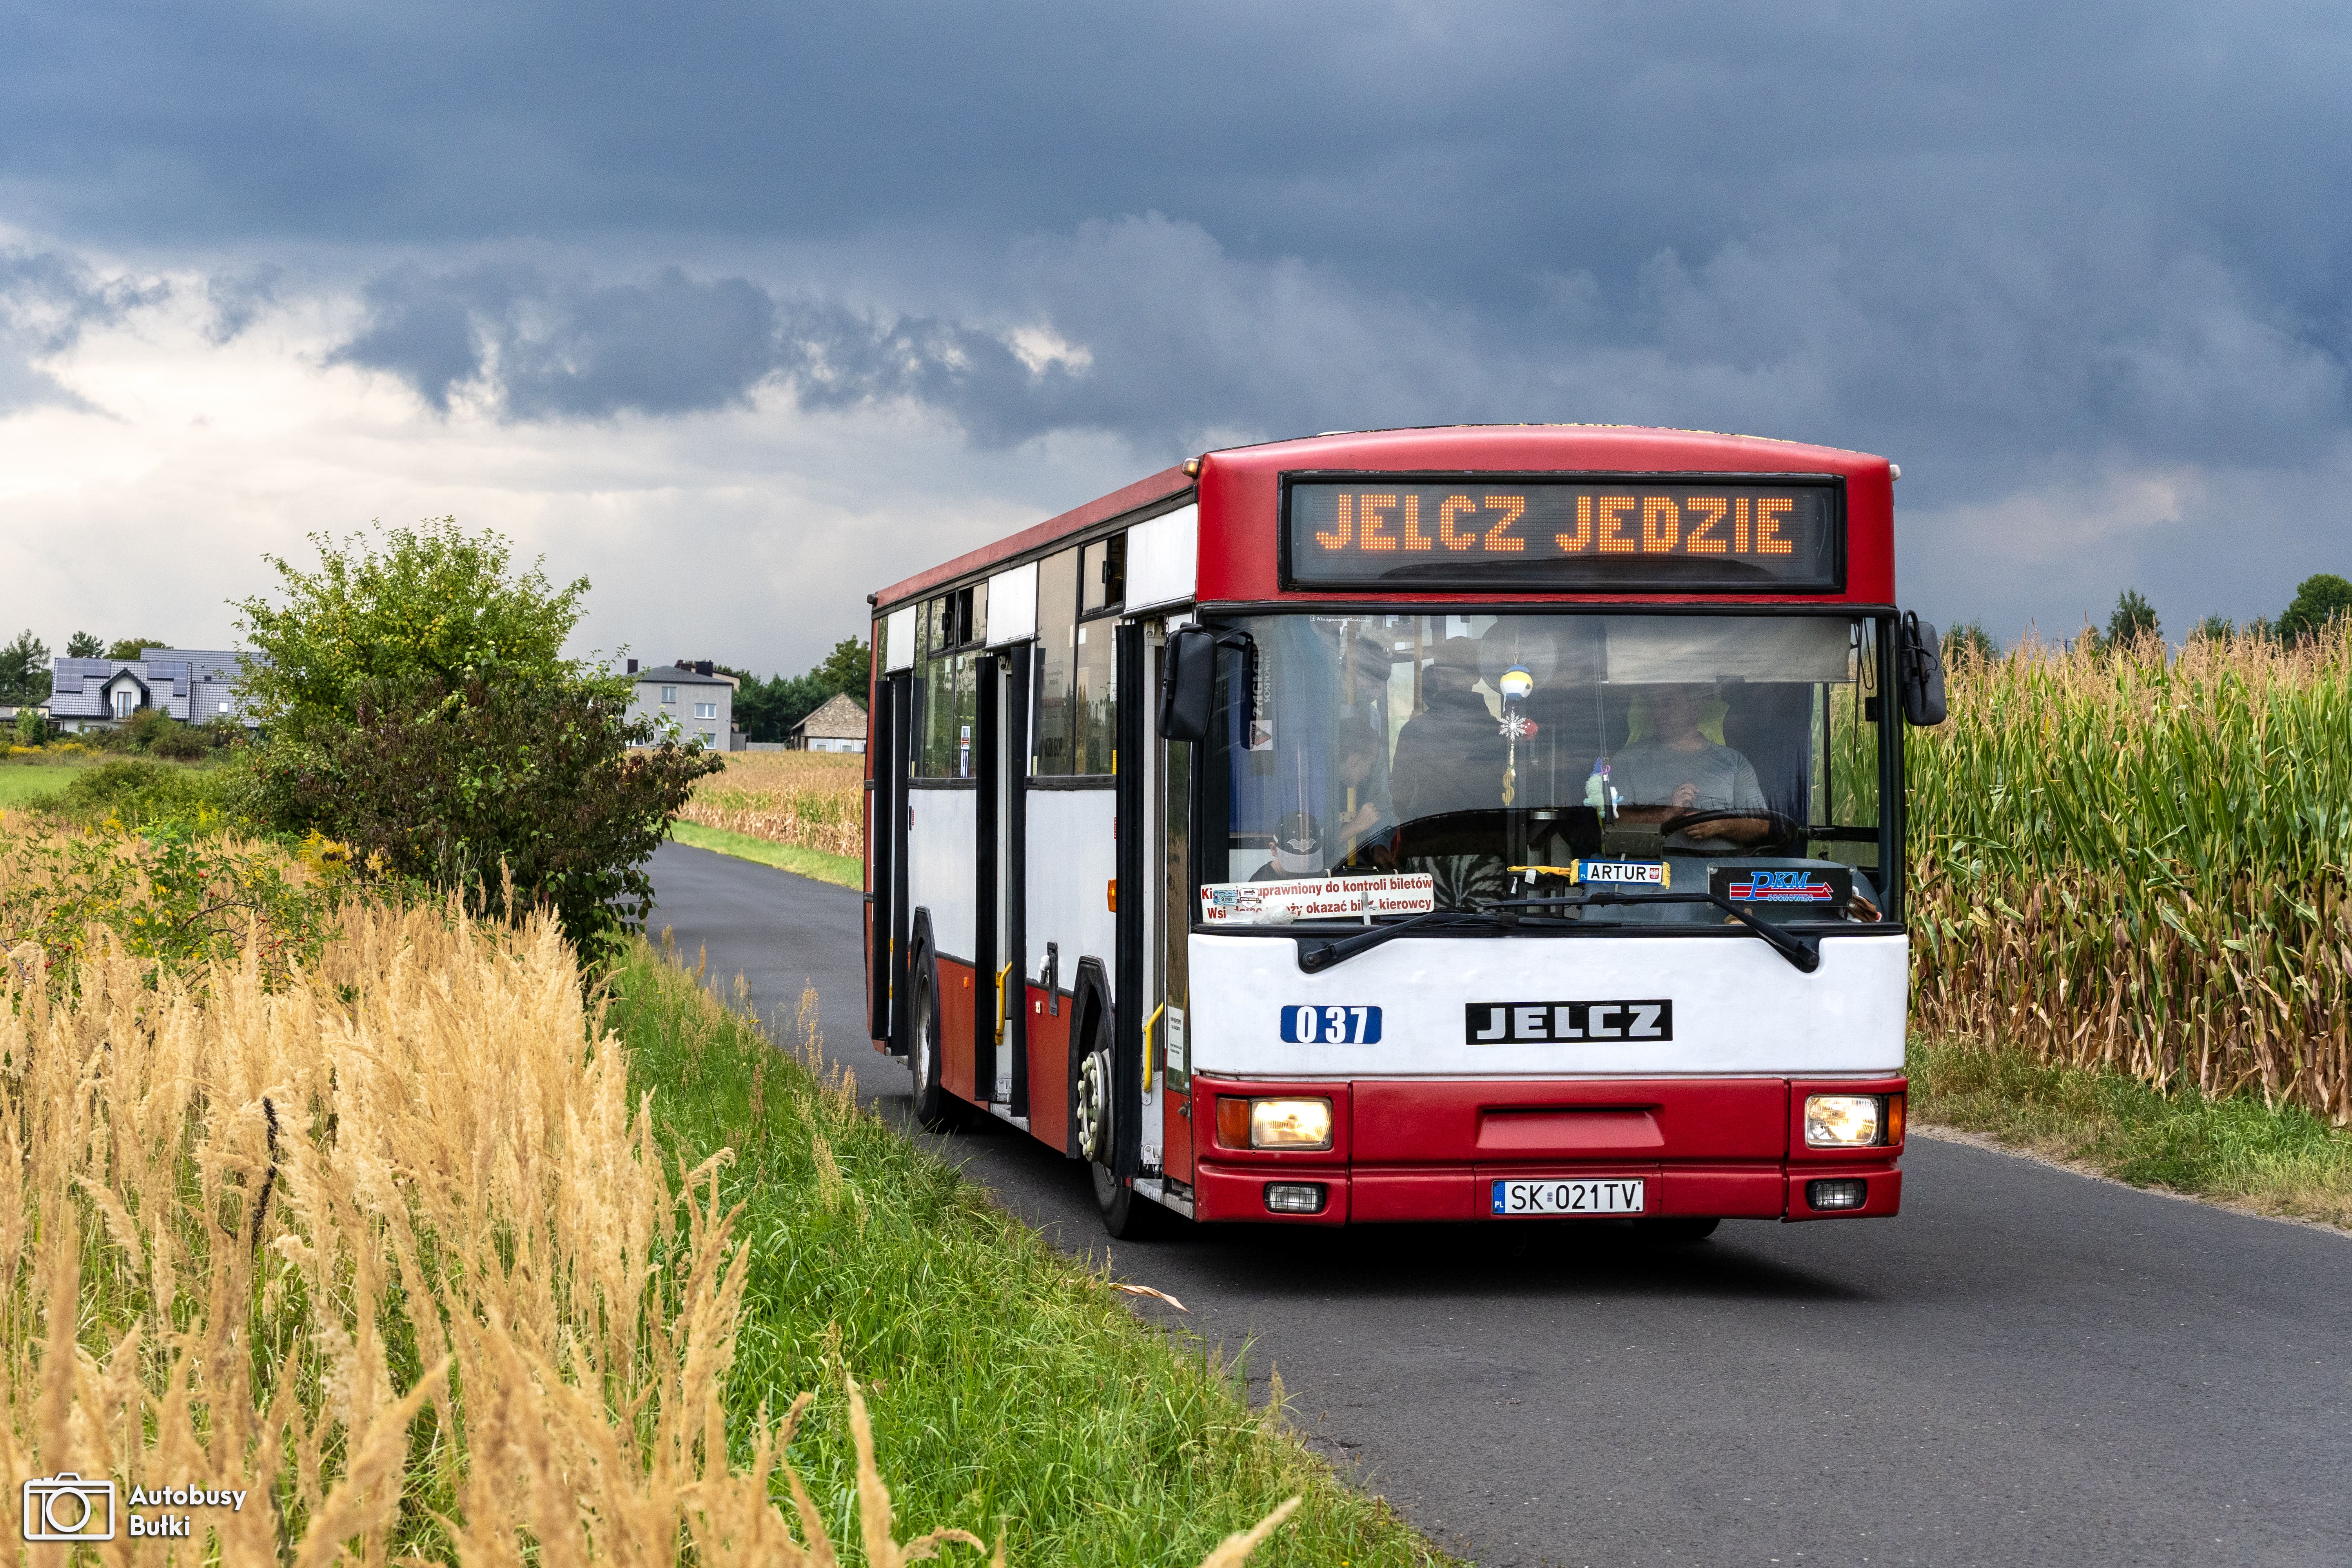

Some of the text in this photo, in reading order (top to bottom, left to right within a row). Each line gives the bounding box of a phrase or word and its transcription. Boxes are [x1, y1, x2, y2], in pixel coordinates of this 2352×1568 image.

[1316, 494, 1793, 553] JELCZ JEDZIE
[960, 750, 969, 777] 037
[1325, 881, 1339, 893] do
[1343, 878, 1387, 892] kontroli
[1390, 877, 1432, 890] biletów
[1591, 865, 1646, 880] ARTUR
[1745, 871, 1811, 901] PKM
[1306, 900, 1347, 914] okazać
[1350, 899, 1374, 911] bil
[1379, 898, 1431, 911] kierowcy
[1768, 893, 1813, 902] SOSNOWIEC
[1296, 1006, 1368, 1044] 037
[1477, 1005, 1662, 1040] JELCZ
[1512, 1185, 1544, 1210] SK
[1556, 1183, 1636, 1209] 021TV
